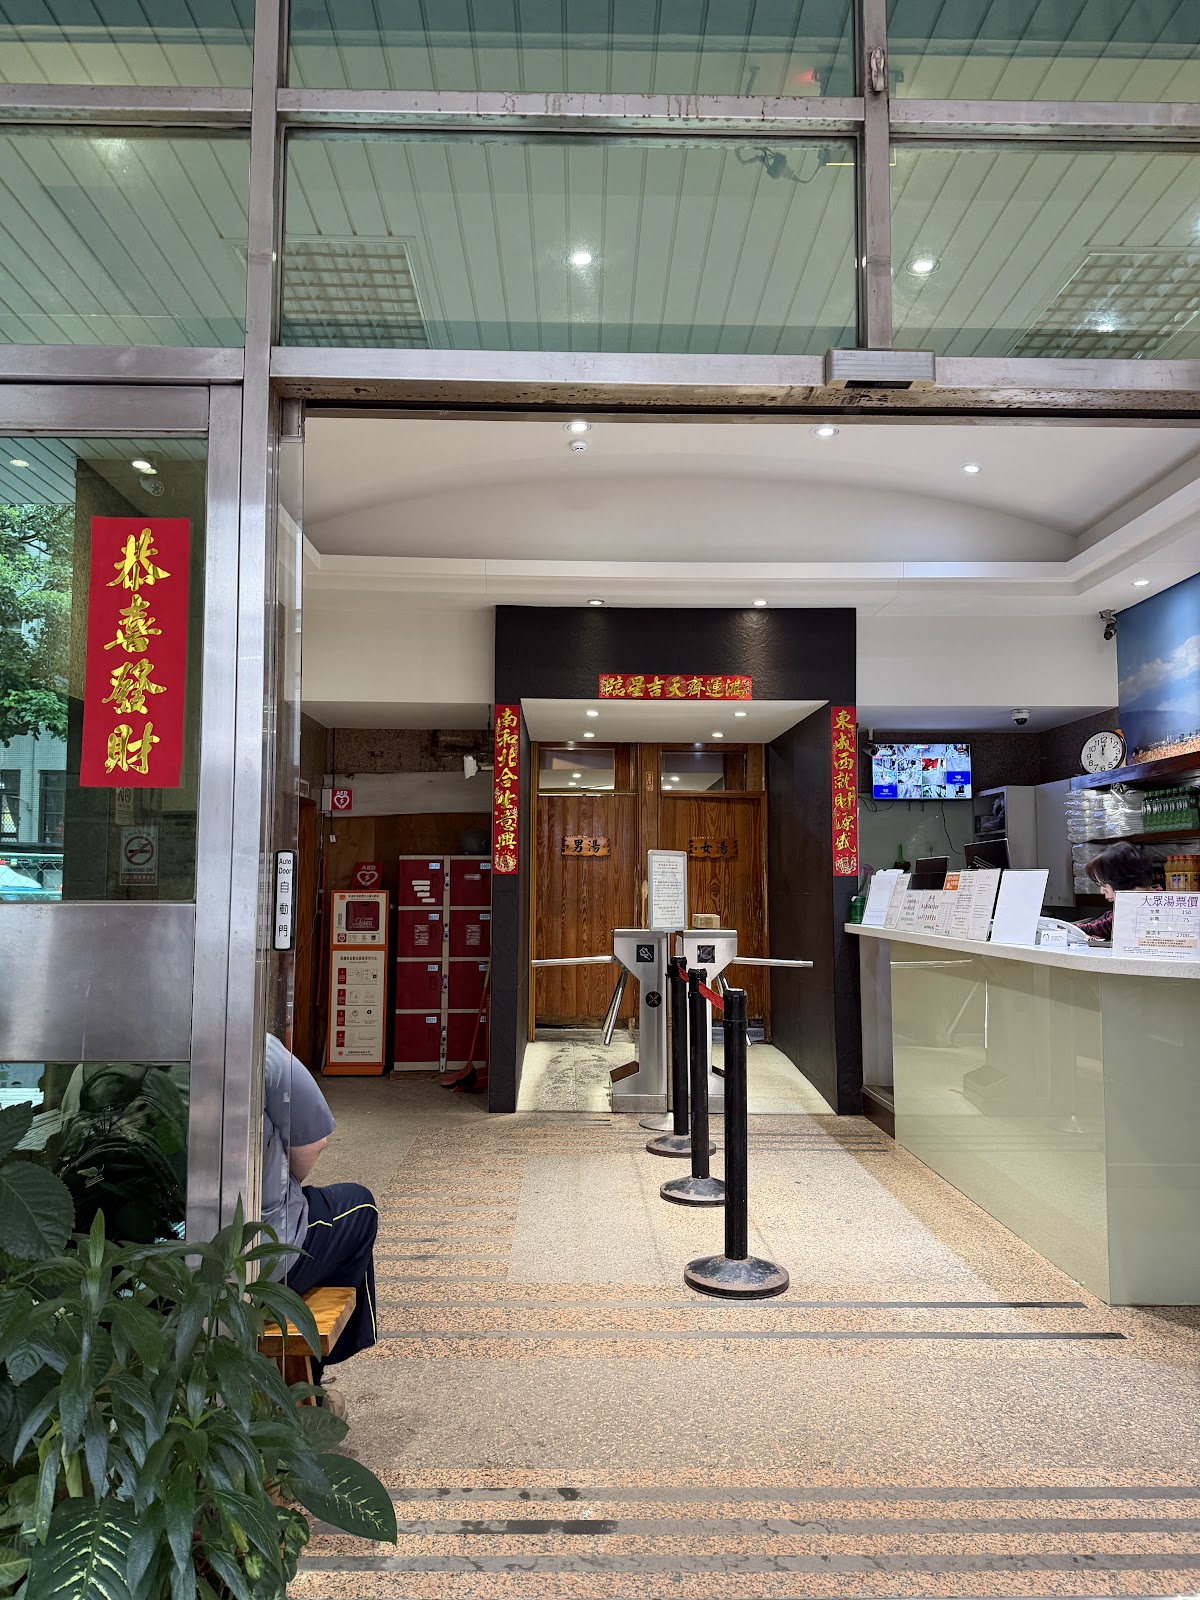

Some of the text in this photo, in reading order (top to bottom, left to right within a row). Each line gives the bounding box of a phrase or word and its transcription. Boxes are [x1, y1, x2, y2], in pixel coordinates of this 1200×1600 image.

[103, 527, 172, 775] 恭喜發財
[495, 707, 519, 850] 南和北合生意興
[572, 838, 601, 853] 男湯
[700, 841, 729, 855] 女湯
[278, 867, 292, 875] Door
[1140, 895, 1199, 908] 大眾湯票價
[278, 881, 289, 938] 自動門
